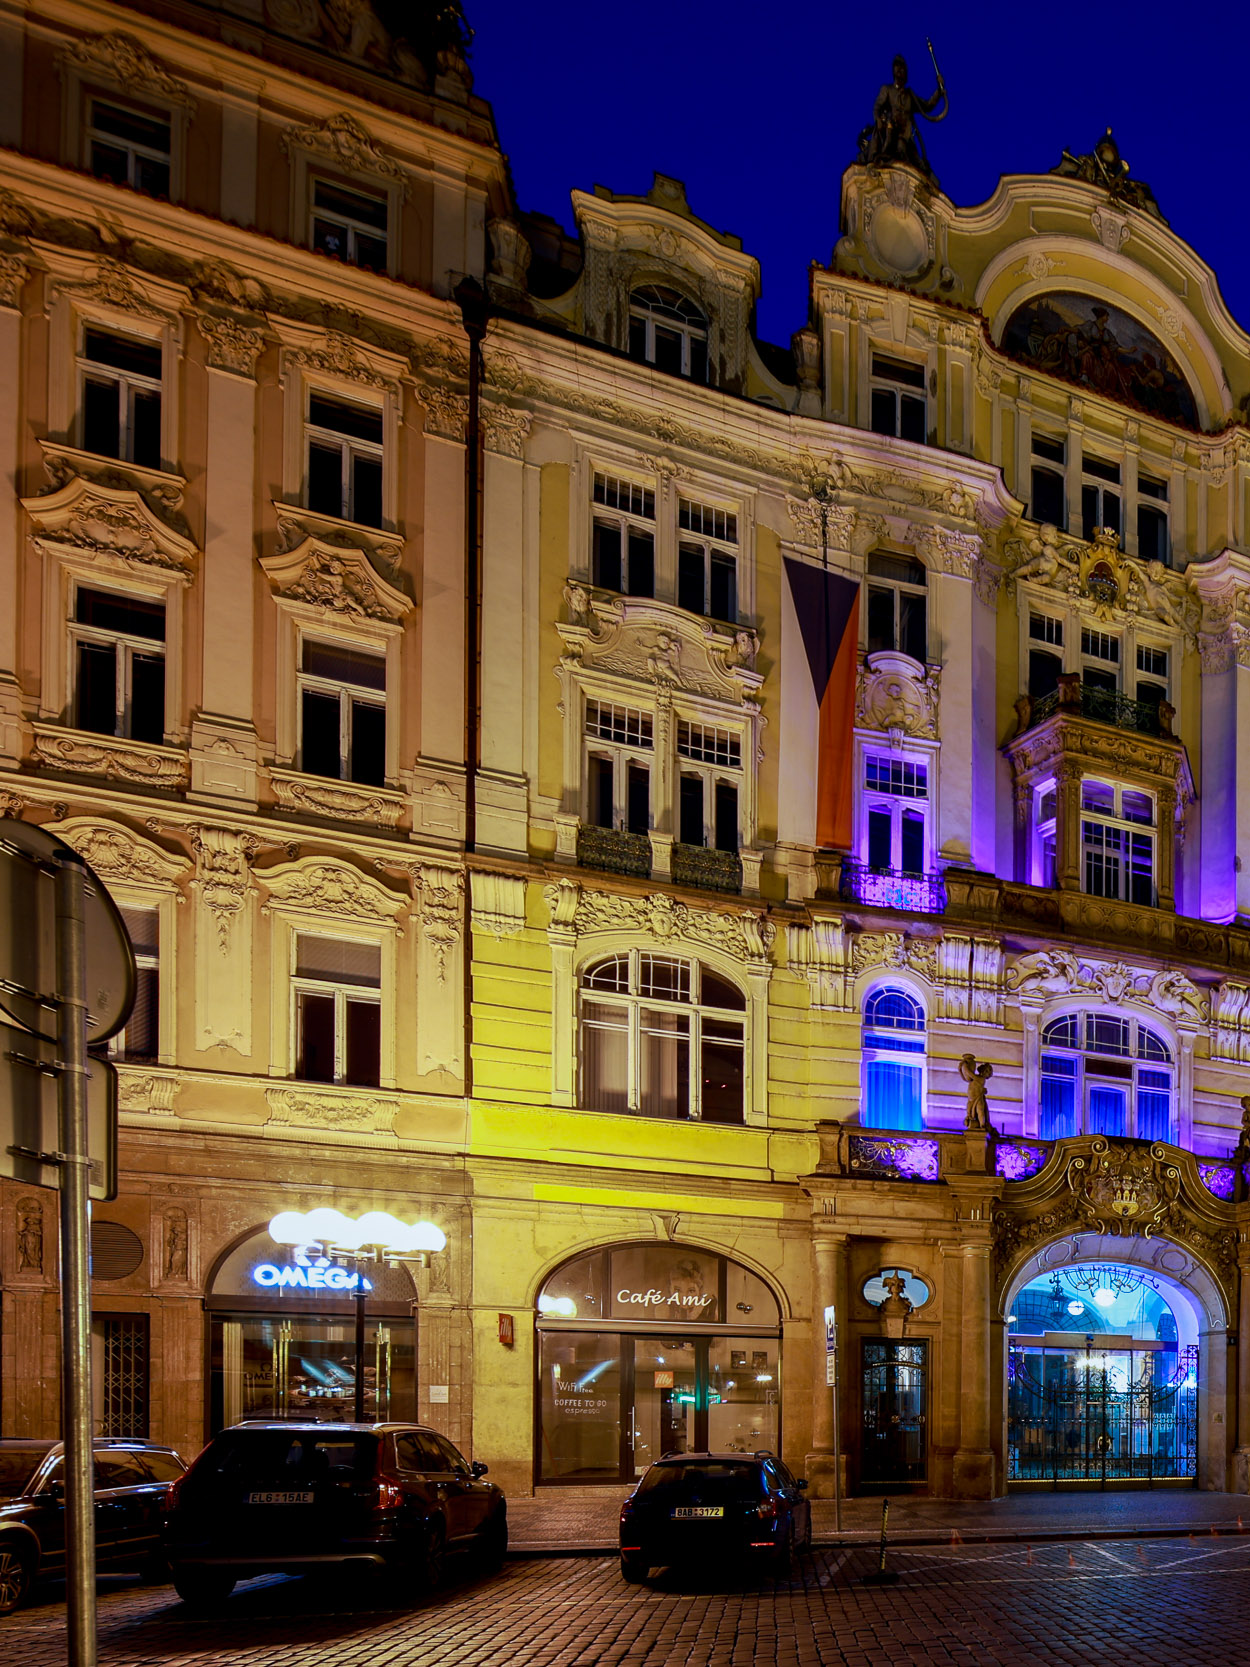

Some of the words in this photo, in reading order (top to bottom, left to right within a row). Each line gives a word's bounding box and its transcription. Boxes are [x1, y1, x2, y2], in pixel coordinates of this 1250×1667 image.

[253, 1264, 373, 1290] OMEGA
[617, 1289, 666, 1307] Café
[666, 1291, 712, 1307] Ami
[244, 1372, 274, 1380] OME
[656, 1373, 673, 1386] illy
[554, 1399, 582, 1407] COFFEE
[699, 1507, 720, 1516] 3172
